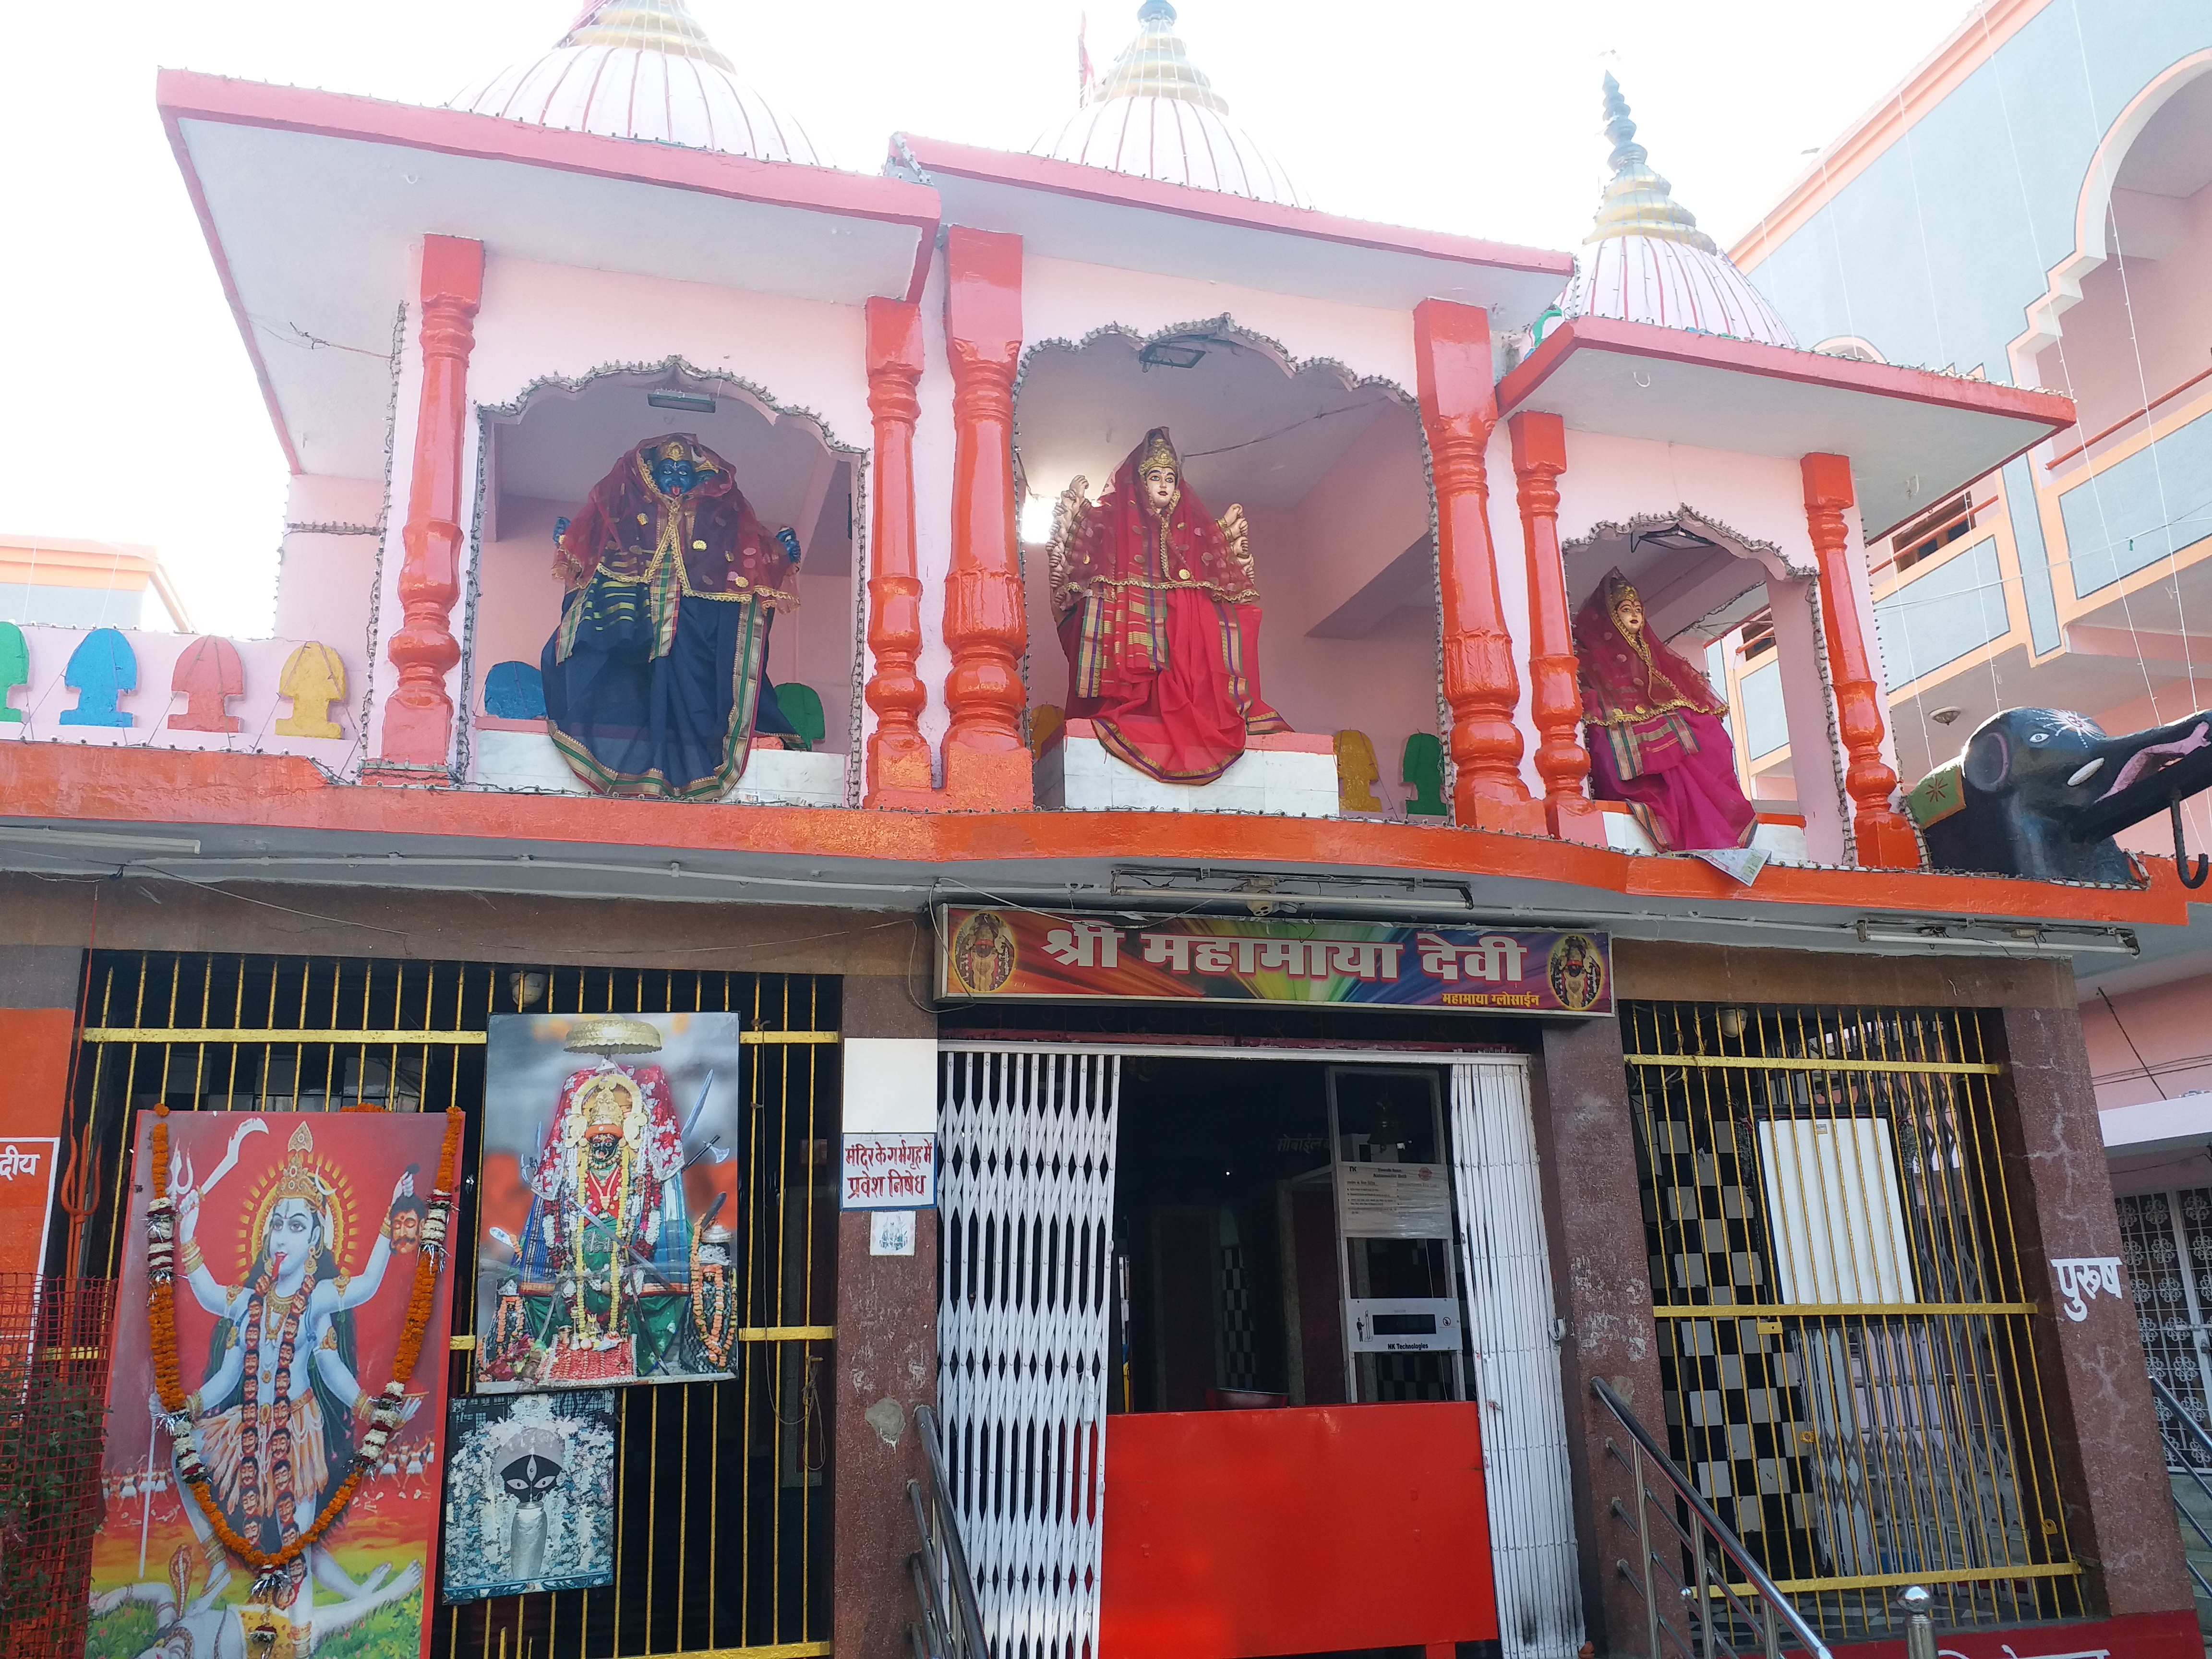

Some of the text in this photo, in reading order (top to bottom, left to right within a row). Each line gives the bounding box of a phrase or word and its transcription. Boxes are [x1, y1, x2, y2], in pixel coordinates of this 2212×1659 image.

[1041, 919, 1527, 981] श्री महामाया देवी
[1442, 991, 1540, 1007] महामाया ग्लोसाईन
[845, 1143, 874, 1171] मंदिर
[875, 1141, 886, 1166] के
[923, 1138, 932, 1165] में
[846, 1169, 927, 1200] प्रवेश निषेध
